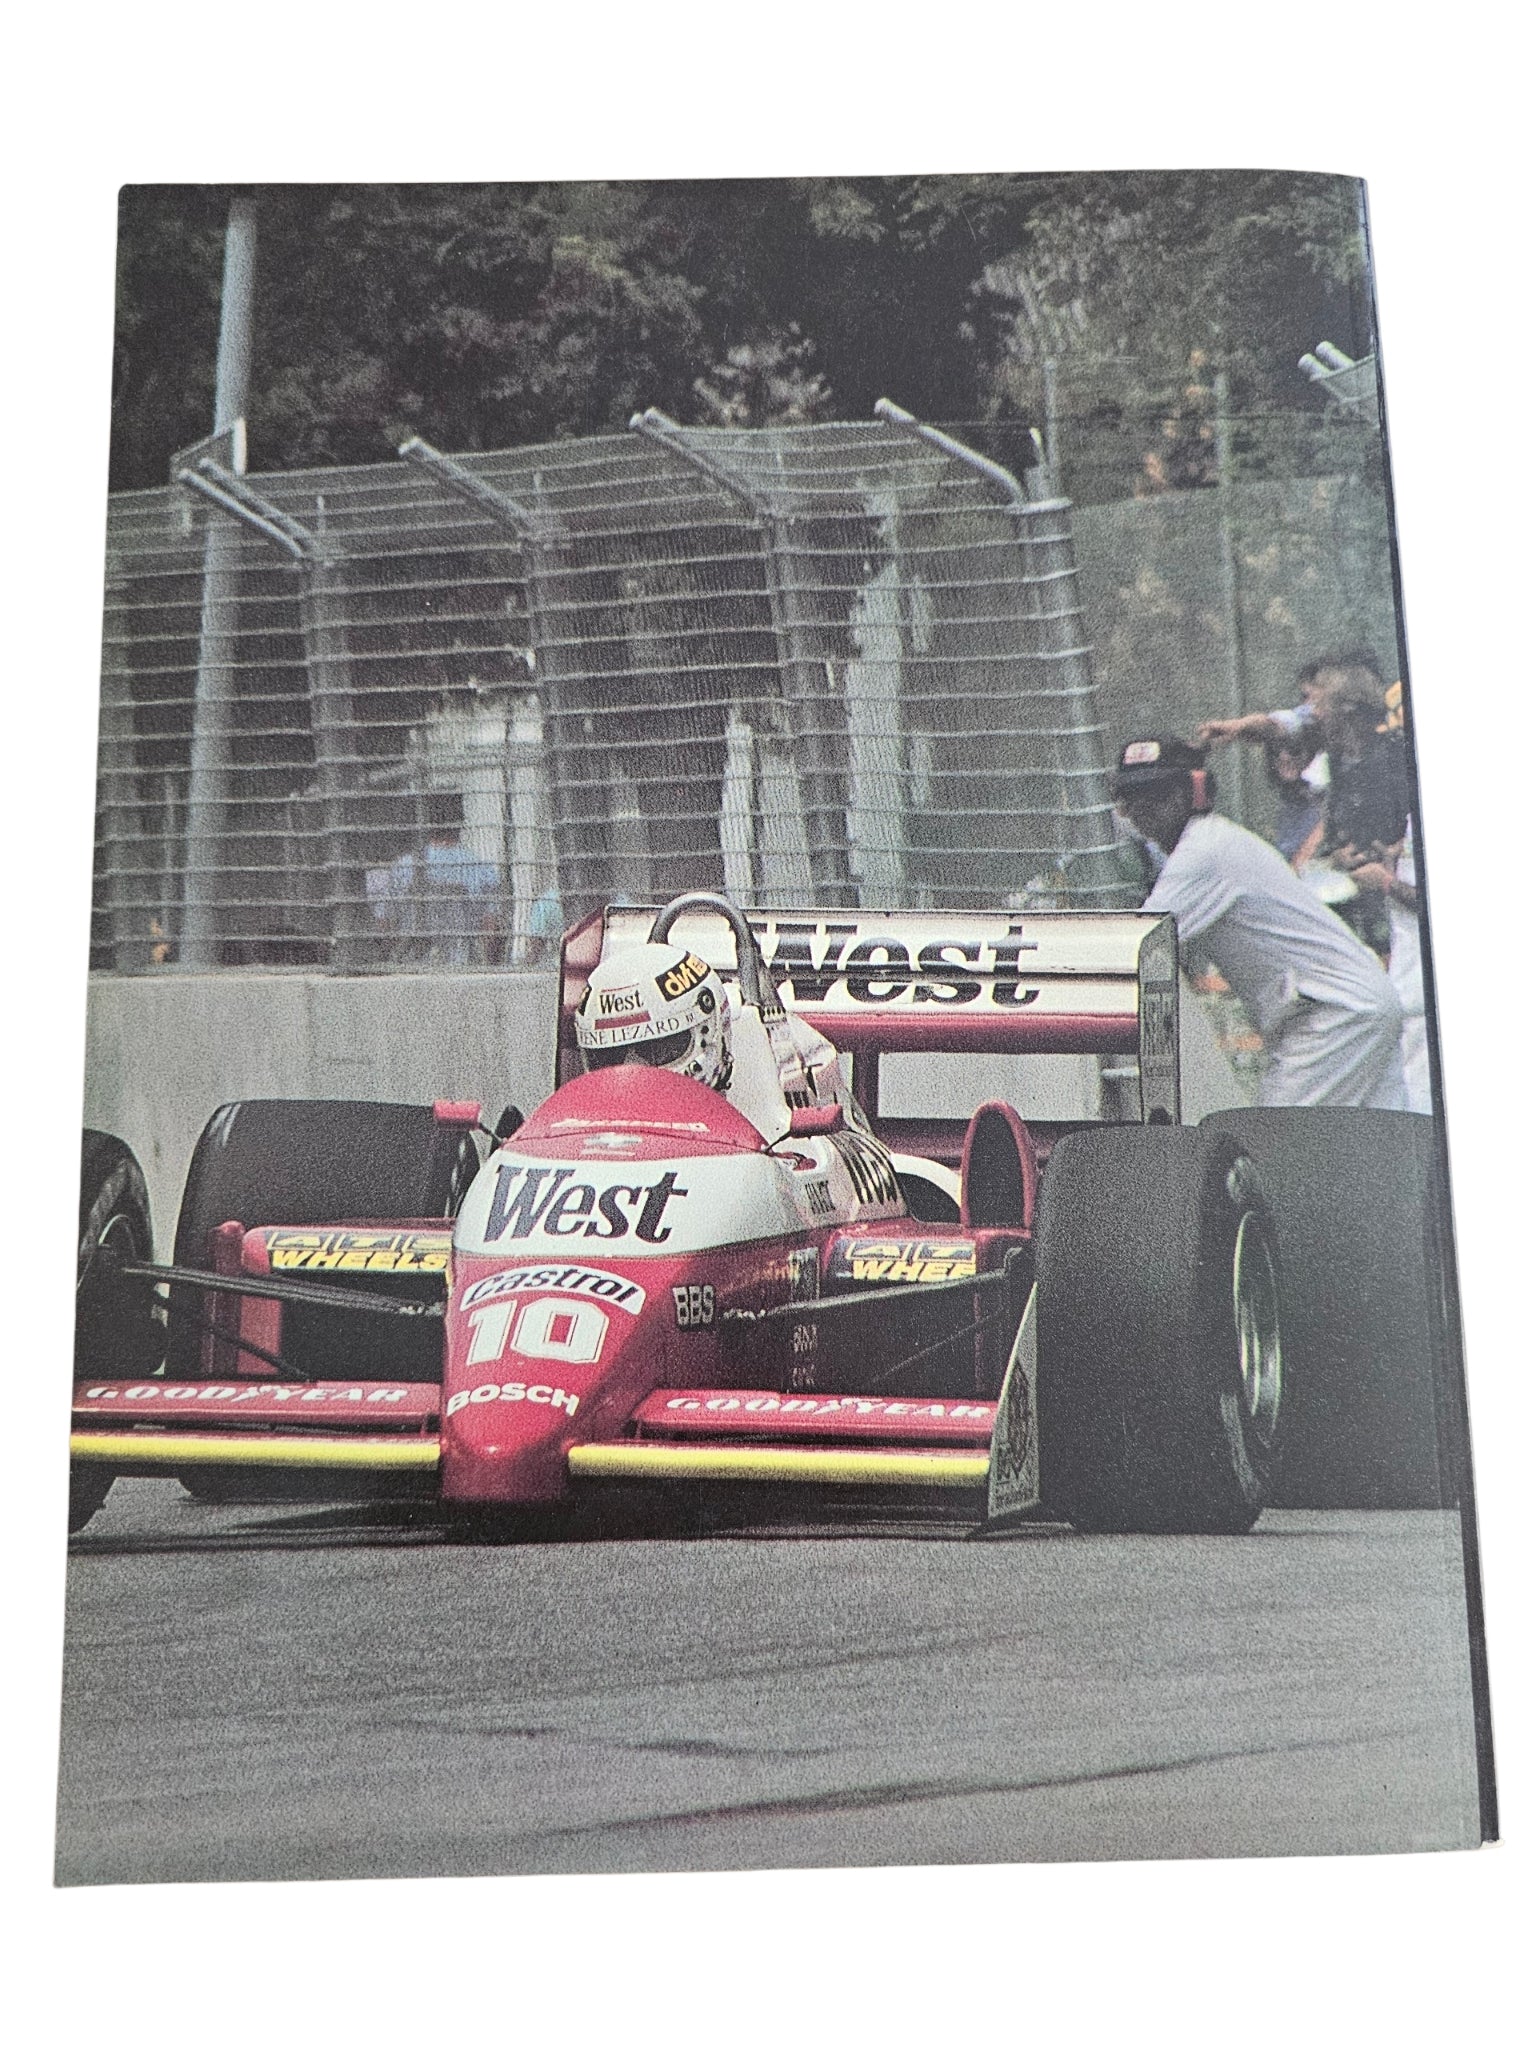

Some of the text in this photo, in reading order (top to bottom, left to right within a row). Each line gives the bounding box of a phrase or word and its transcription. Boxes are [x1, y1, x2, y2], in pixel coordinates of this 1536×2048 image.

[750, 921, 1040, 1008] West
[599, 990, 644, 1015] West
[611, 1017, 680, 1042] LEZARD
[483, 1164, 688, 1244] West
[272, 1250, 448, 1271] WHEELS
[468, 1269, 640, 1304] Castrol
[672, 1285, 715, 1326] BBS
[466, 1301, 609, 1366] 10
[86, 1383, 408, 1402] GOODYEAR
[447, 1382, 580, 1417] BOSCH
[666, 1397, 992, 1420] GOODYEAR
